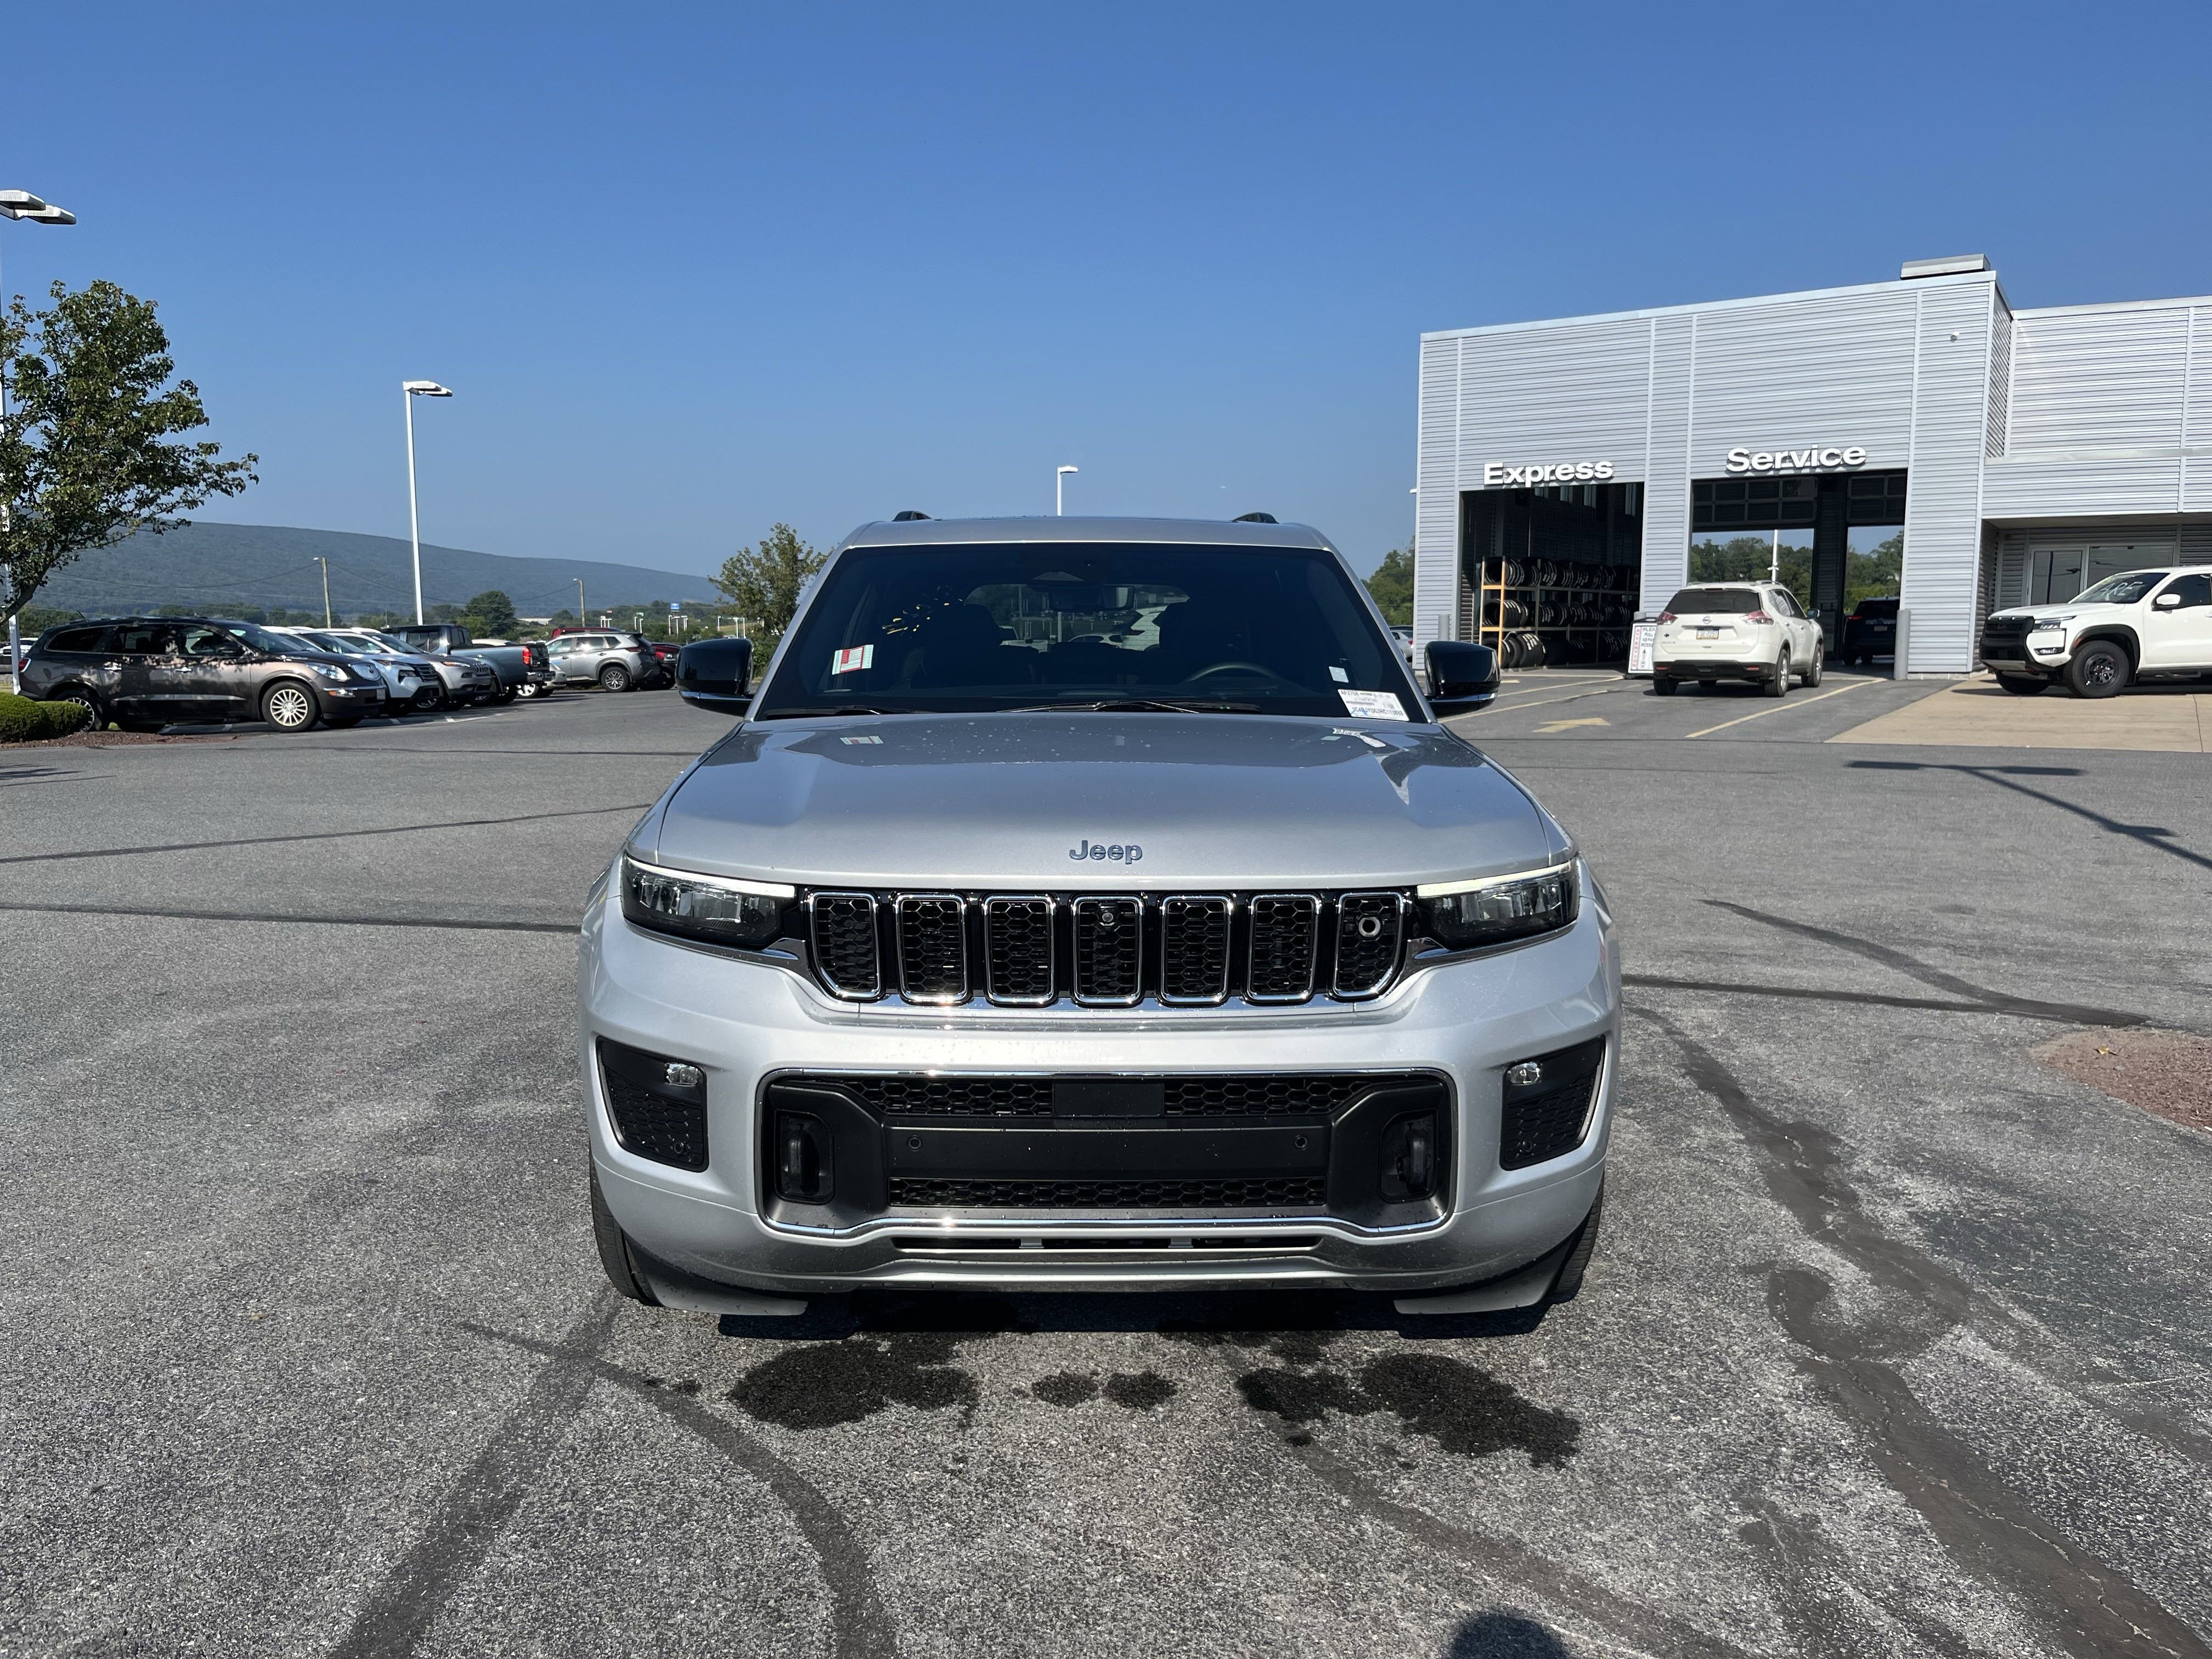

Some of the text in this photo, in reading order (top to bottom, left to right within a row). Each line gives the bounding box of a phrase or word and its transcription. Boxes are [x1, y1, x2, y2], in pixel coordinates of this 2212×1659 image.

[1726, 444, 1866, 472] Service
[1483, 461, 1613, 487] Express
[1069, 840, 1143, 865] Jeep
